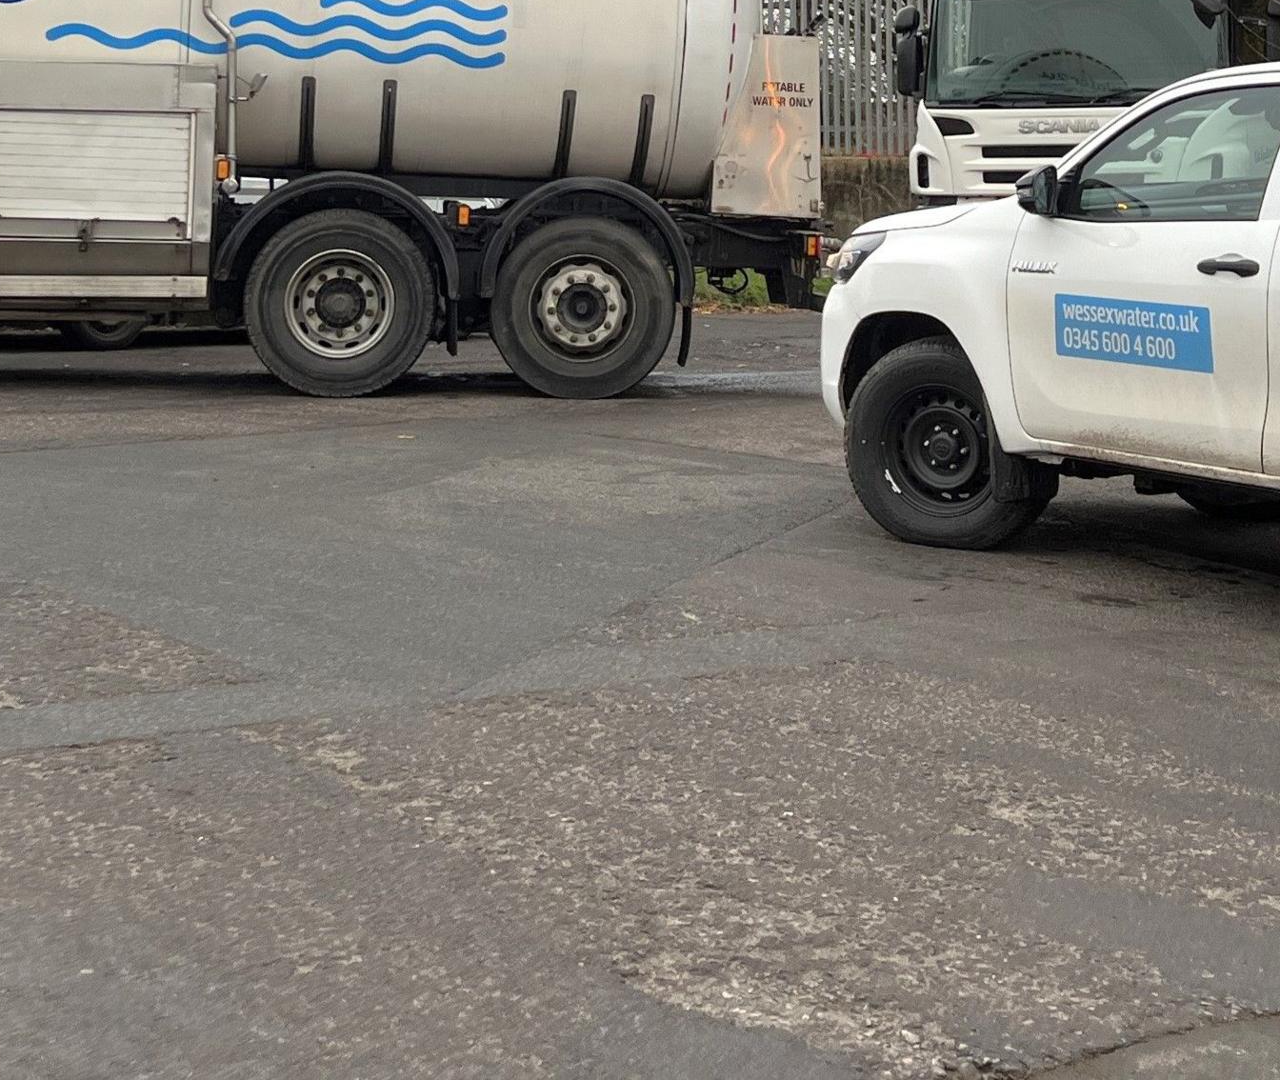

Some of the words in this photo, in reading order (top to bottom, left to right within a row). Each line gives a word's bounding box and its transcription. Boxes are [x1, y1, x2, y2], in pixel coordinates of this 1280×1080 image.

[789, 96, 814, 108] ONLY
[1018, 119, 1099, 134] SCANIA
[1063, 303, 1200, 333] wessexwater.co.uk
[1063, 327, 1099, 351] 0345
[1102, 332, 1131, 355] 600
[1133, 335, 1144, 356] 4
[1146, 337, 1176, 360] 600
